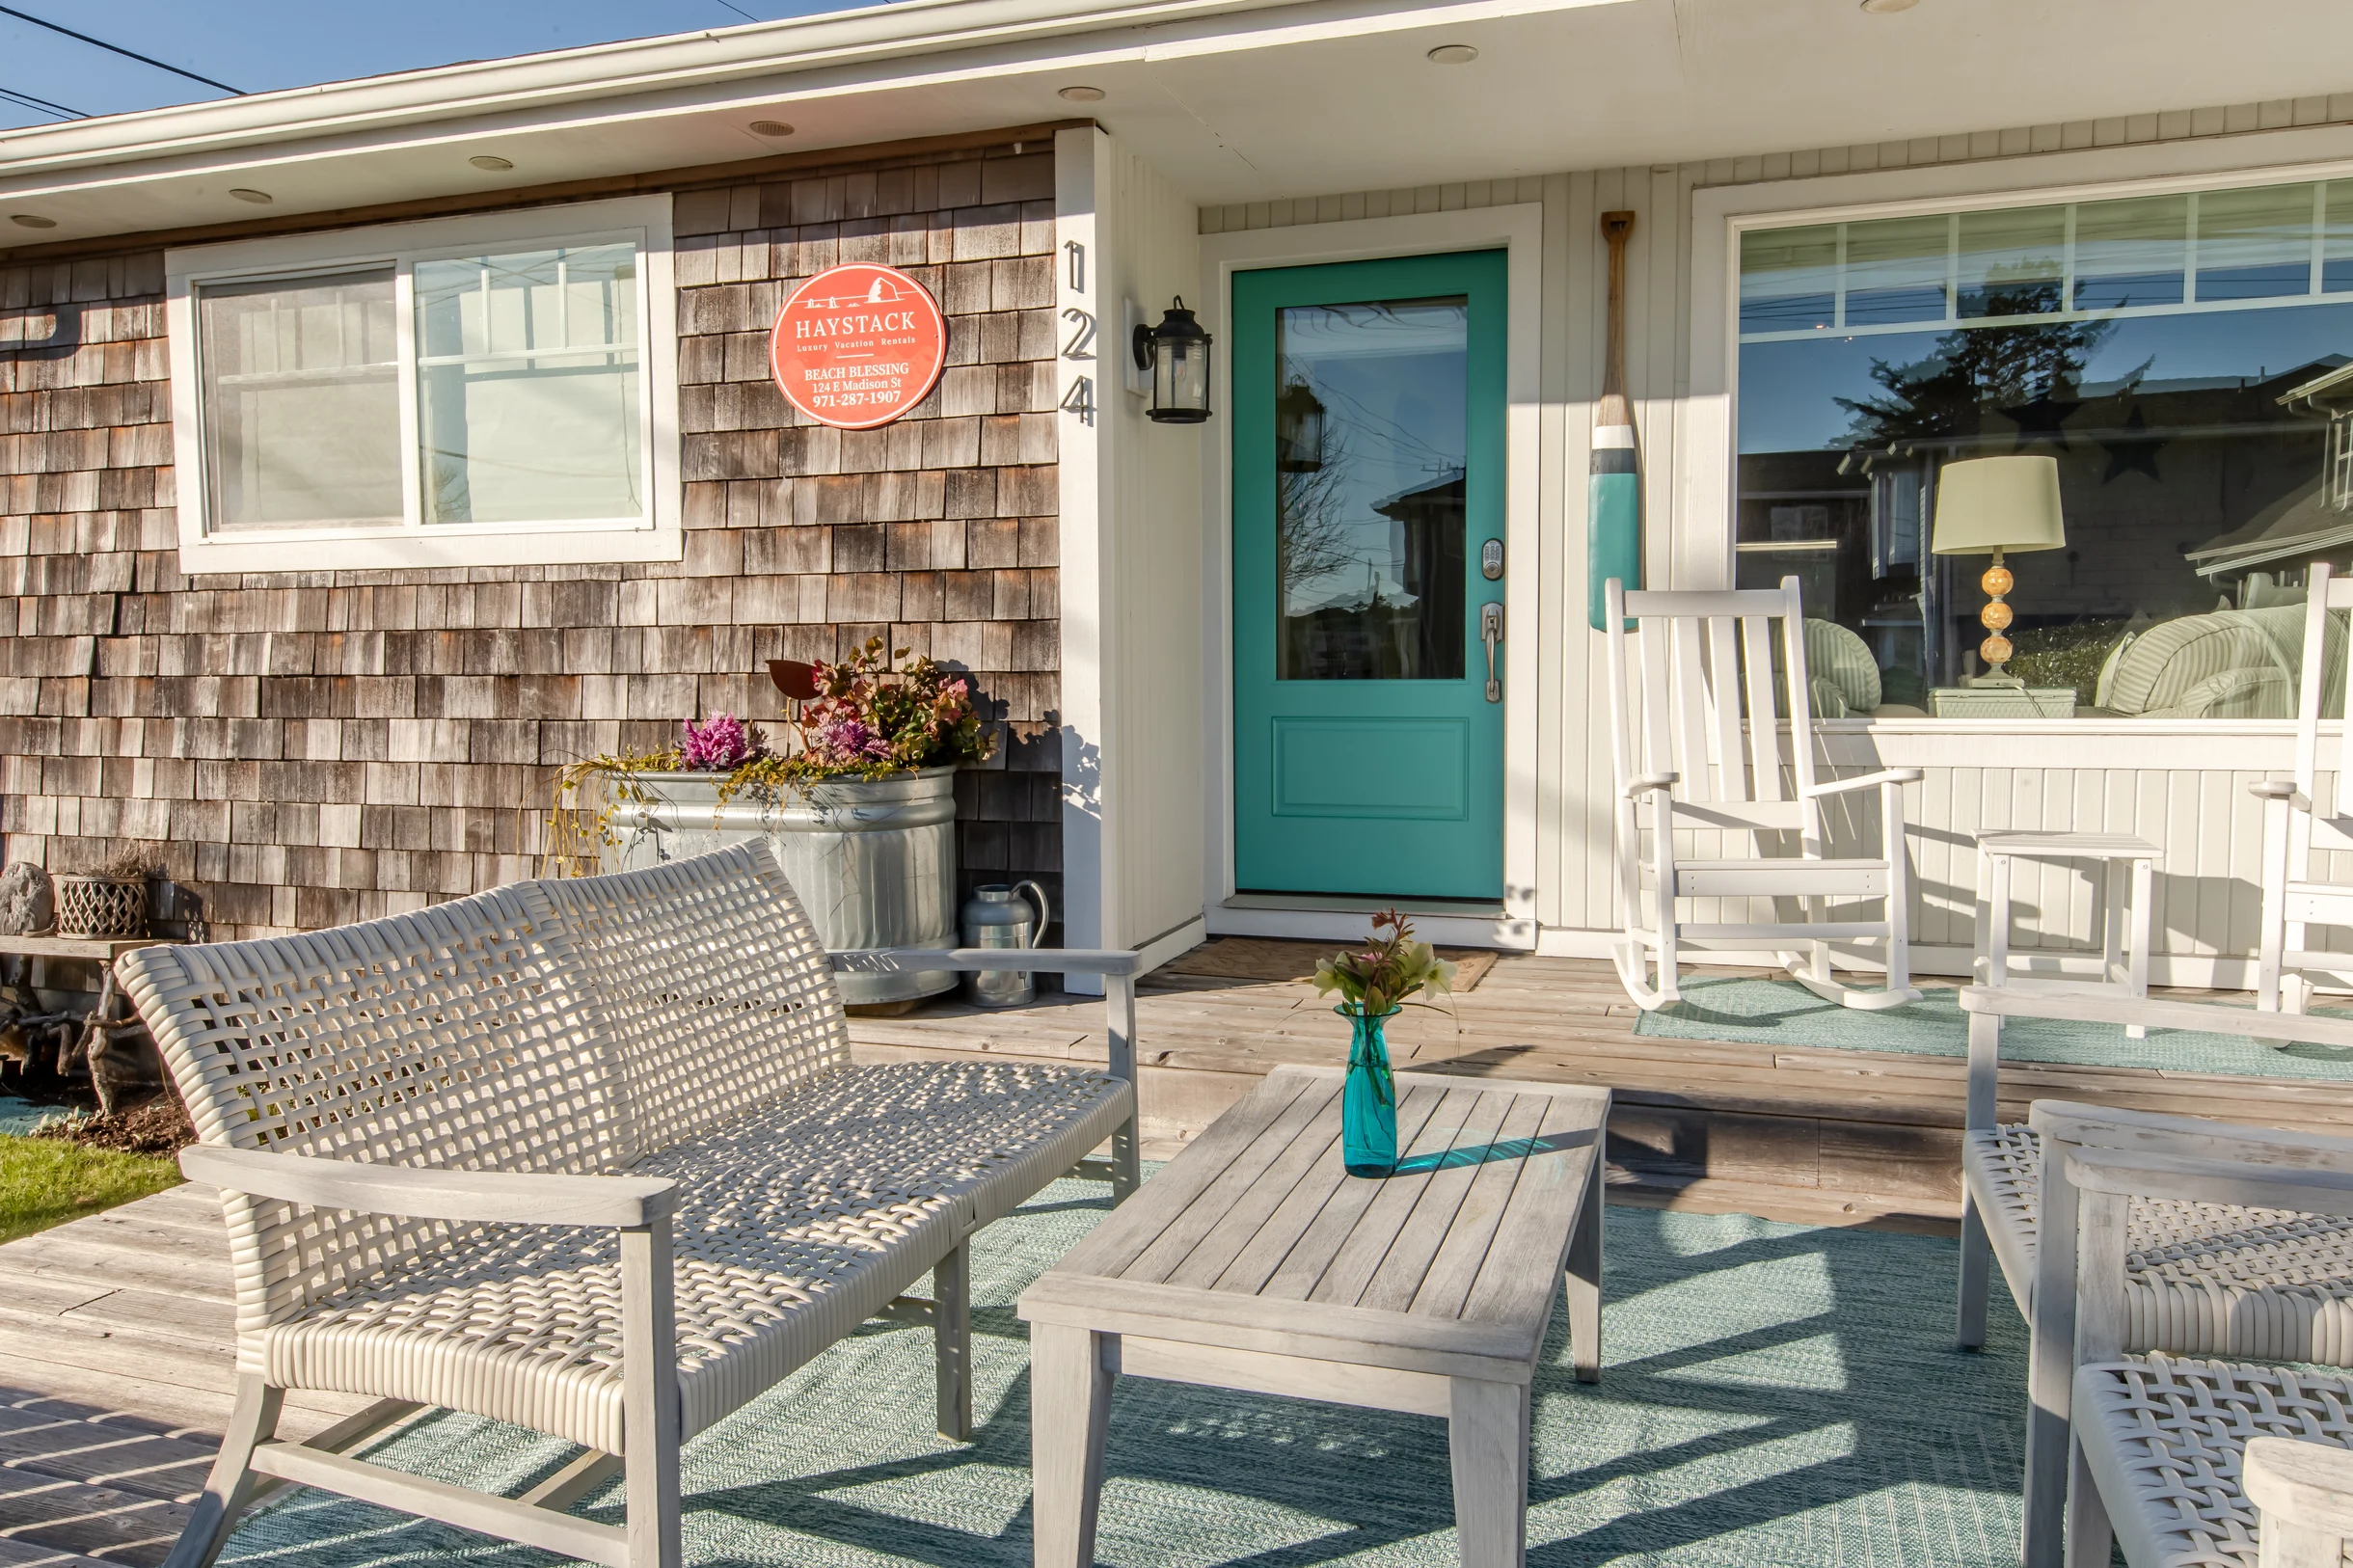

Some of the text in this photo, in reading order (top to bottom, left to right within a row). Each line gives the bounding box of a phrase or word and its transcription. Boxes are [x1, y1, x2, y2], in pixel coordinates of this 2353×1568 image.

[796, 312, 915, 338] HAYSTACK
[1060, 239, 1090, 423] 124
[835, 340, 874, 349] Vacation
[881, 337, 915, 345] Rentals
[804, 363, 909, 381] BEACH BLESSING
[813, 378, 902, 392] 124 E Madison St
[813, 391, 901, 407] 971-287-1907
